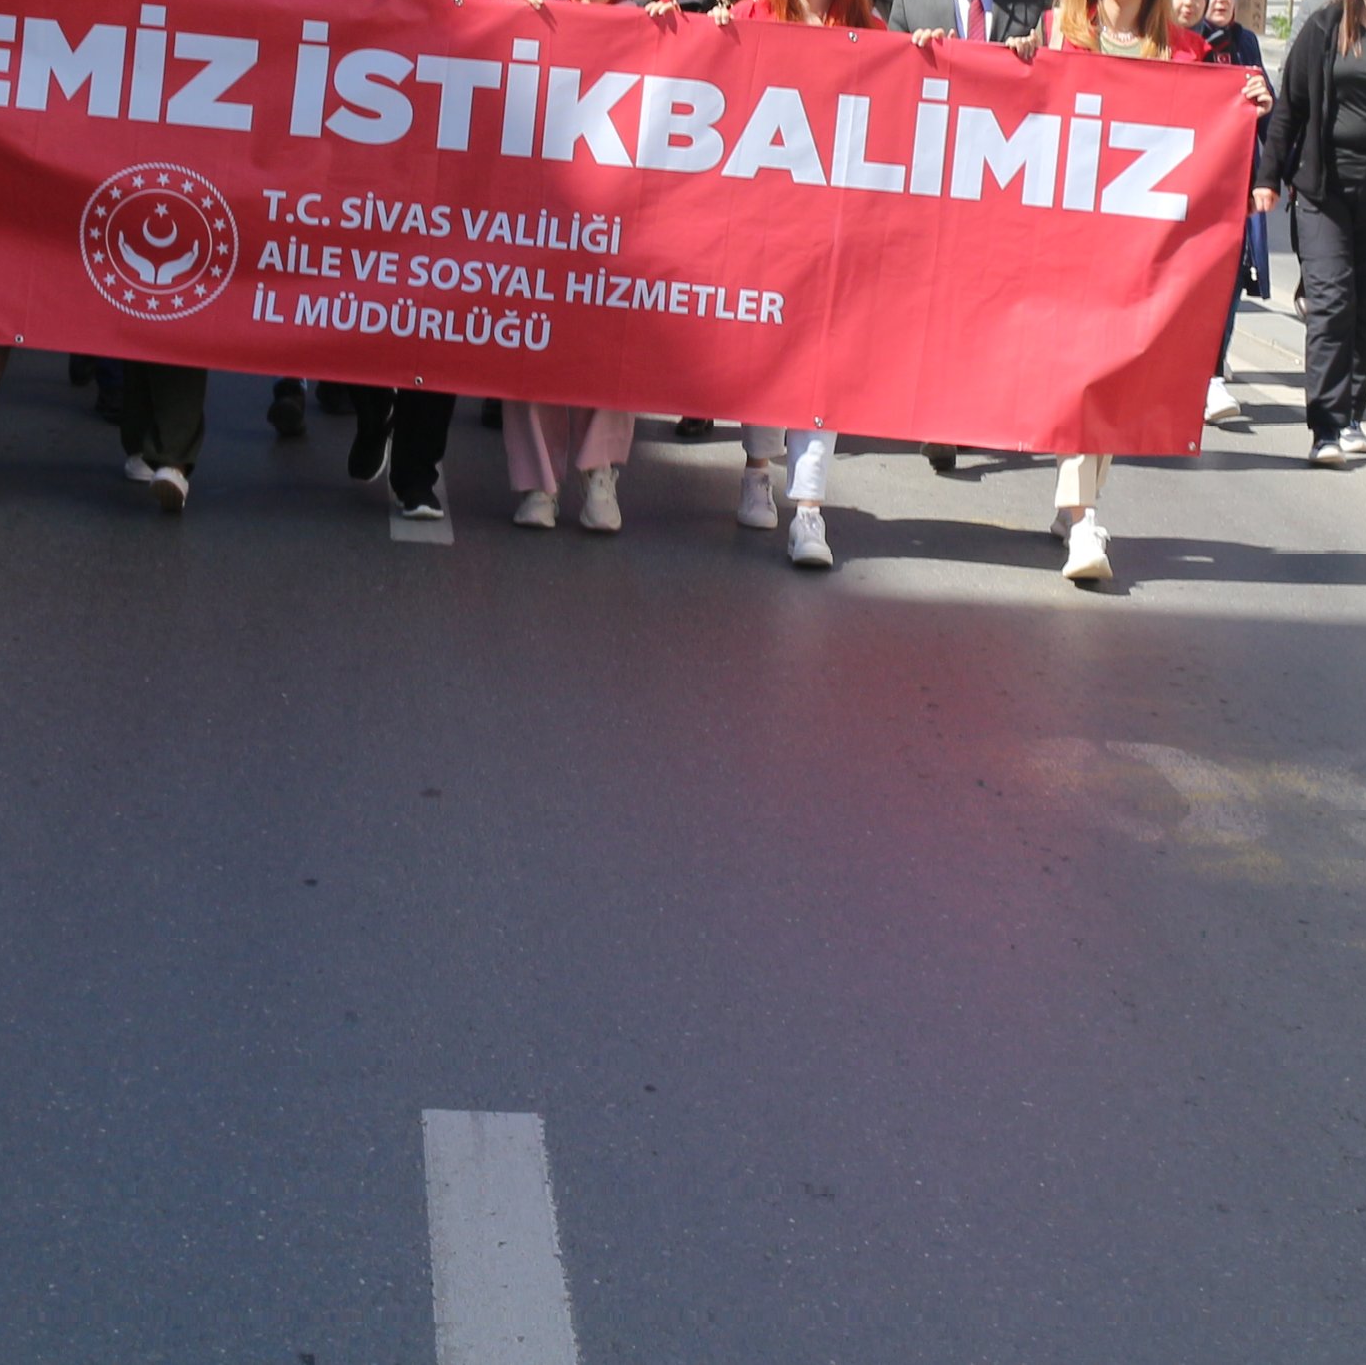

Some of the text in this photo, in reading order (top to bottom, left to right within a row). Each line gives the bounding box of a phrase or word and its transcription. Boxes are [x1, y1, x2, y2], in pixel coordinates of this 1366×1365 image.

[290, 20, 1195, 222] İSTİKBALİMİZ
[263, 190, 621, 255] T.C. SİVAS VALİLİĞİ
[253, 282, 550, 351] İL MÜDÜRLÜĞÜ
[258, 236, 784, 324] AİLE VE SOSYAL HİZMETLER
